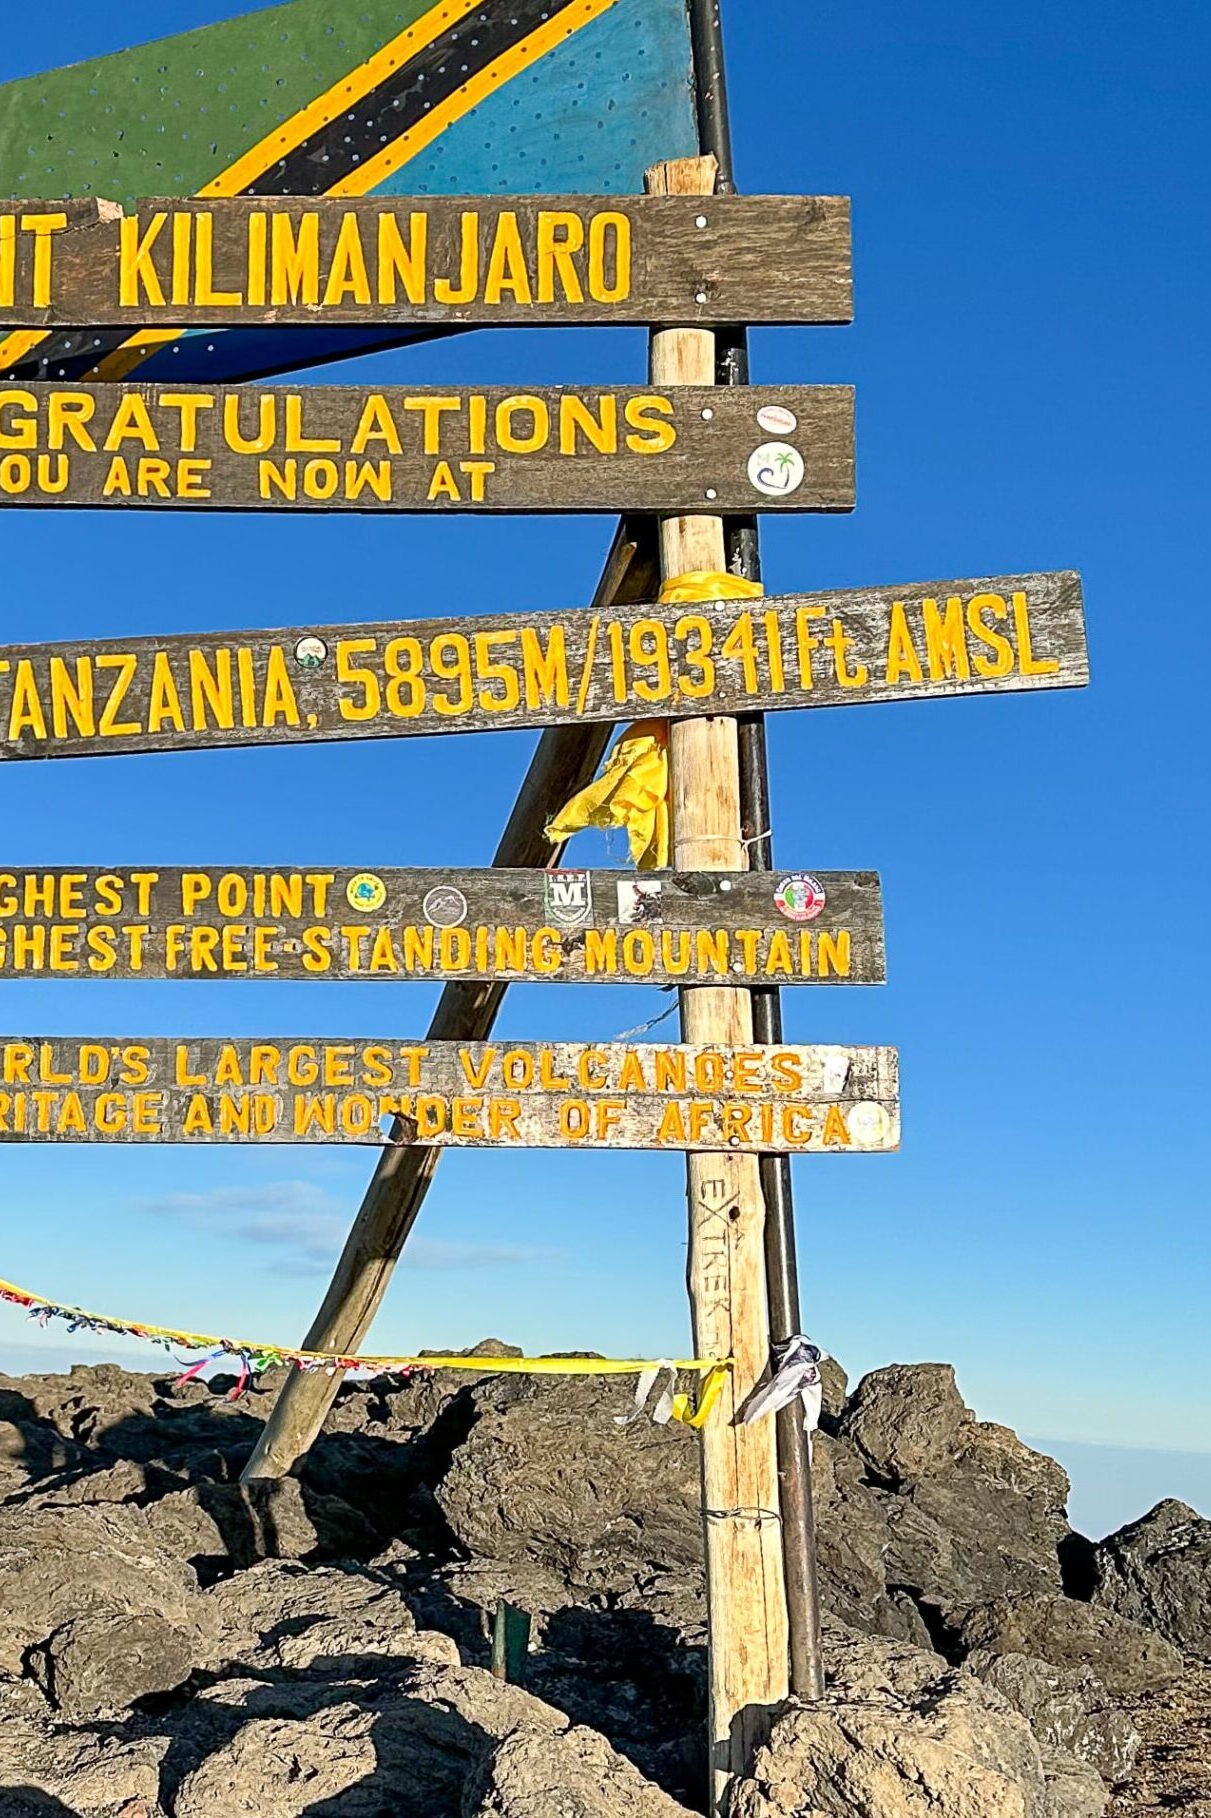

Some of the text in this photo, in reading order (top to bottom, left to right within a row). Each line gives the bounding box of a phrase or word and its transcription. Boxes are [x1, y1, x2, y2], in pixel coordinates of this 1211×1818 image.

[120, 210, 632, 307] KILIMANJARO
[102, 457, 212, 498] ARE
[259, 459, 392, 501] NOW
[427, 460, 496, 502] AT
[885, 591, 1060, 684] AMSL
[181, 872, 336, 919] POINT
[164, 924, 562, 975] FREE-STANDING
[584, 928, 852, 977] MOUNTAIN
[175, 1045, 430, 1088] LARGEST
[458, 1048, 802, 1093] VOLCANOES
[183, 1093, 276, 1136] AND
[559, 1098, 627, 1140] OF
[659, 1101, 852, 1145] AFRICA
